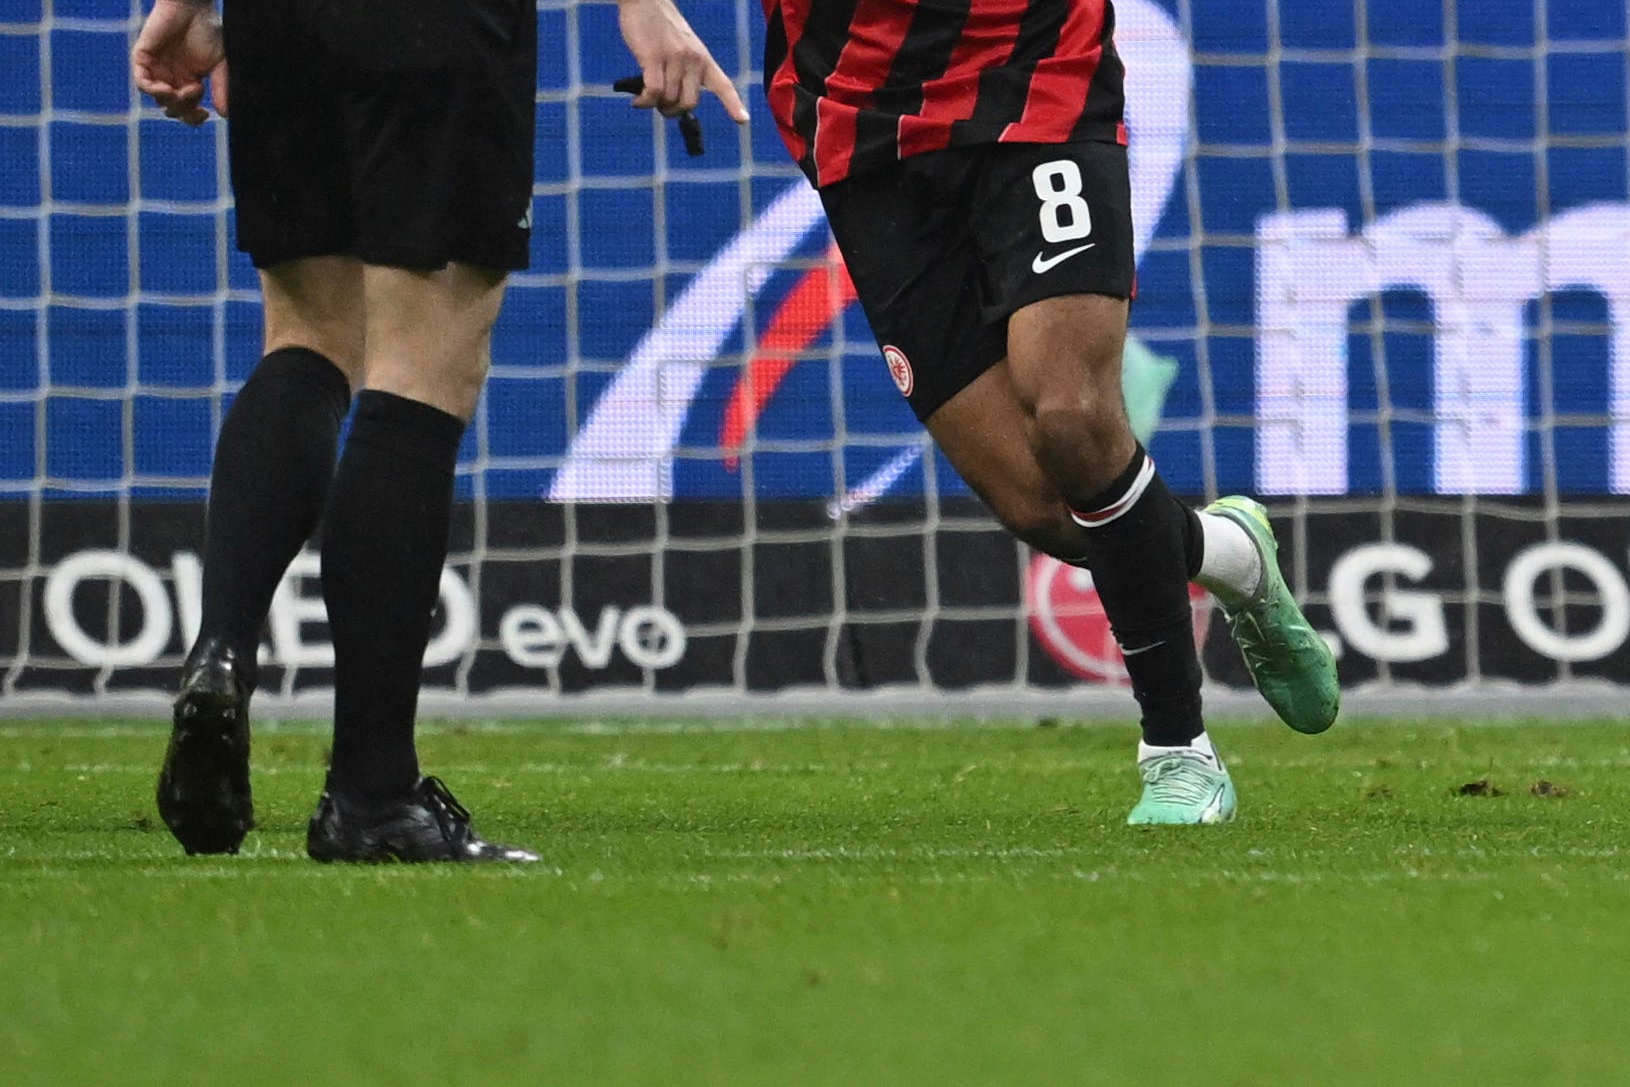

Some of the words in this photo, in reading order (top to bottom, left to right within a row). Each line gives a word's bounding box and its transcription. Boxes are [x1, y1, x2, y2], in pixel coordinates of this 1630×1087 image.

[1032, 159, 1092, 244] 8
[501, 605, 687, 670] evo
[1325, 544, 1449, 663] G
